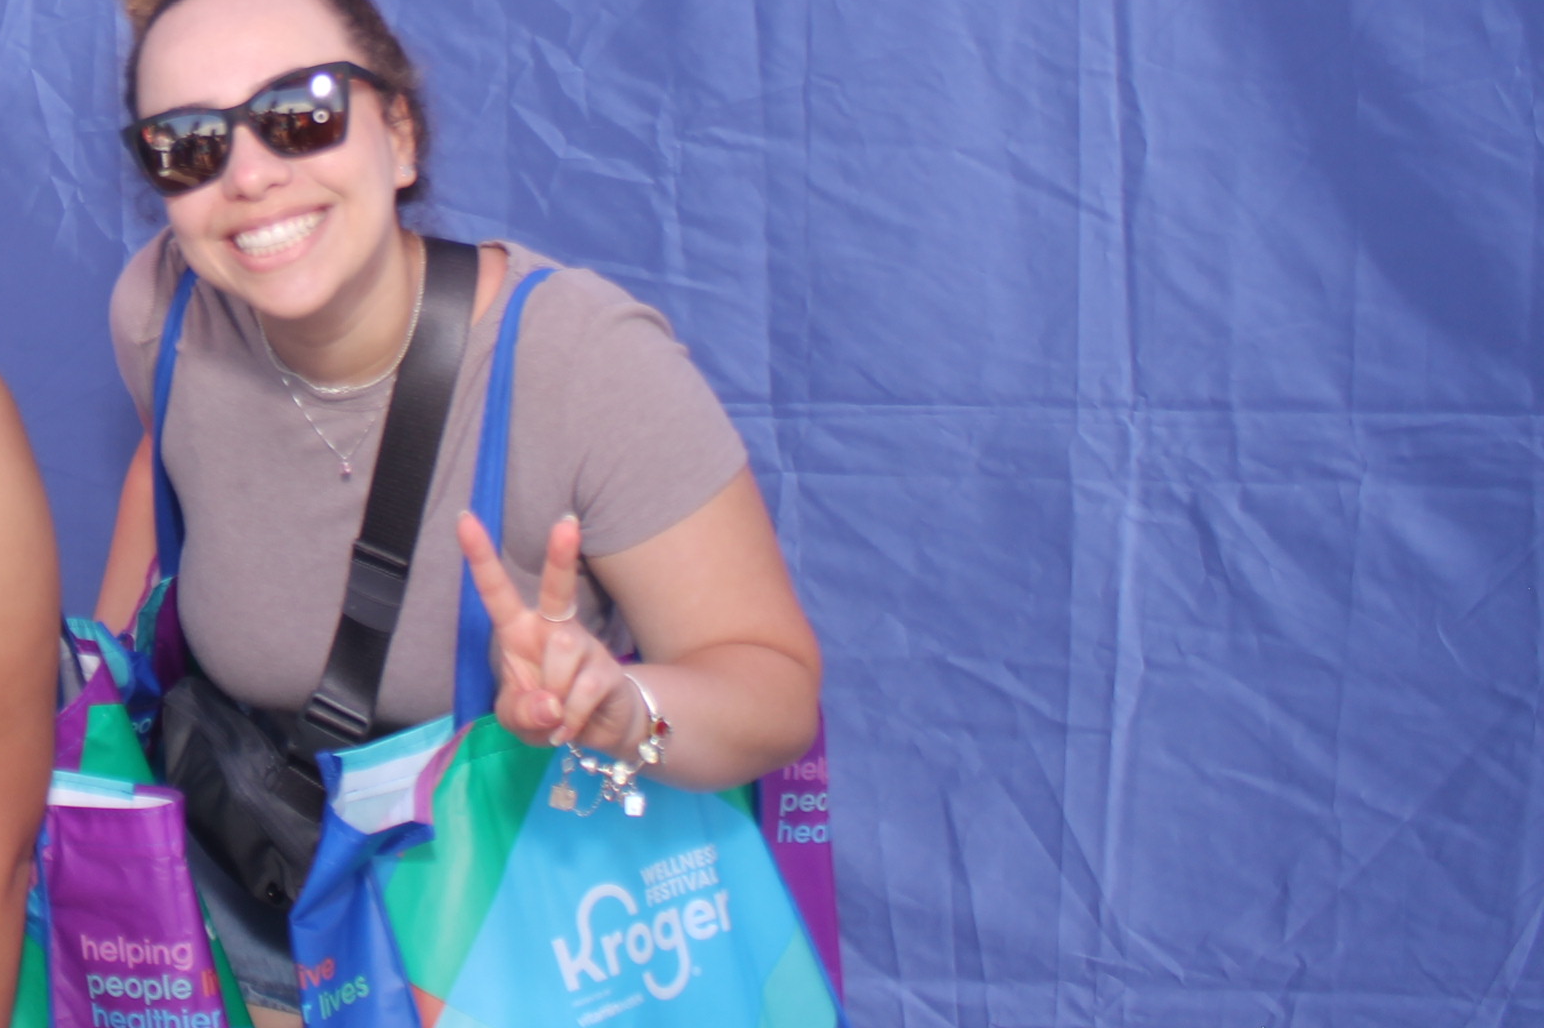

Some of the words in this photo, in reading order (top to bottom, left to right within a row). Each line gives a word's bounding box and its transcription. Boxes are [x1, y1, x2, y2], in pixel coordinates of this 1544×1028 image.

[645, 866, 720, 908] FESTIVAL
[80, 934, 194, 971] helping
[551, 881, 731, 1001] Kroger
[87, 973, 193, 1005] people
[319, 975, 369, 1020] lives
[91, 1003, 223, 1028] healthier
